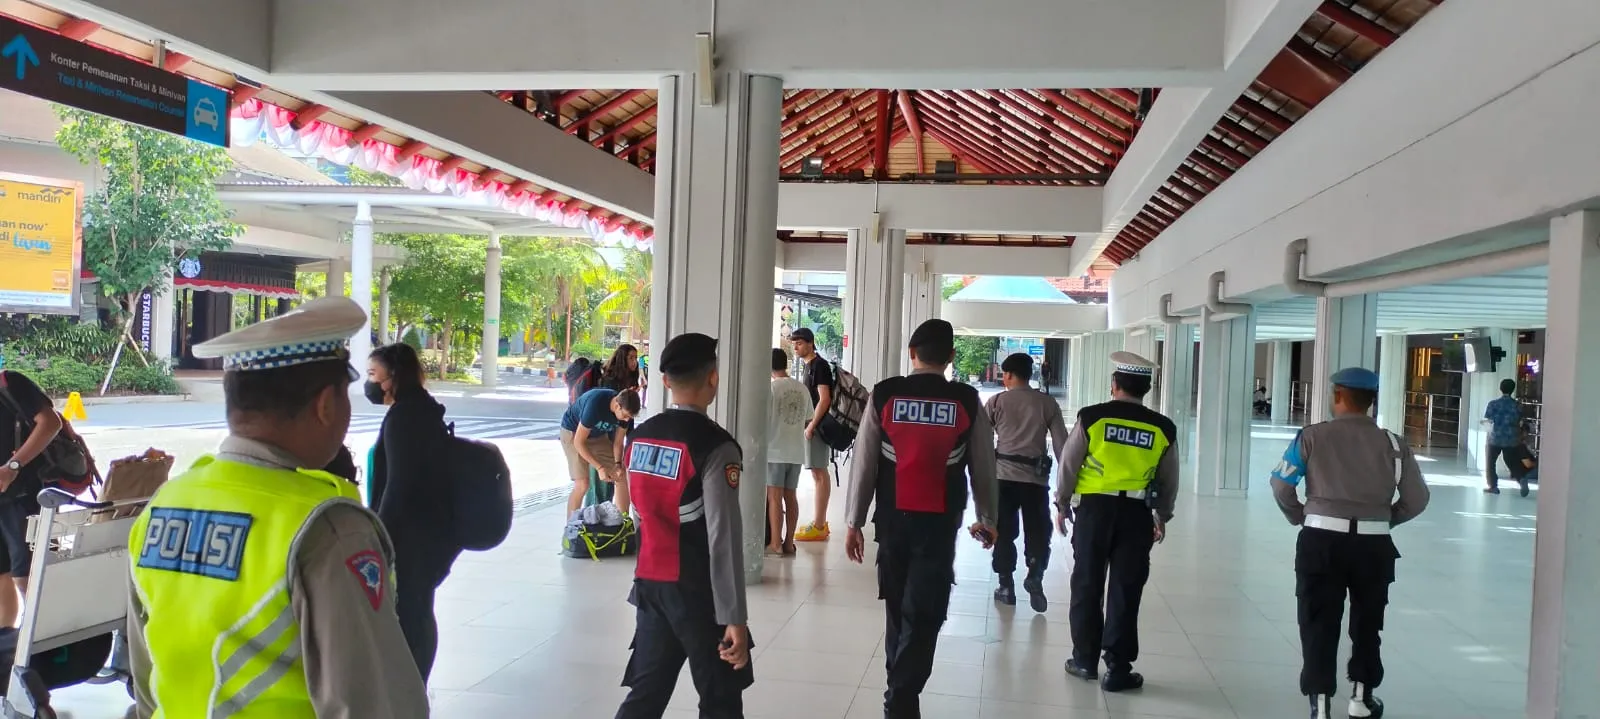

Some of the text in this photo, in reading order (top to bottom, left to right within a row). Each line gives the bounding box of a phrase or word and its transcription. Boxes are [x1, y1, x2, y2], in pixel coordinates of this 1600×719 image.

[50, 52, 186, 103] Konter Pemesanan Taksi & Minivan
[18, 191, 61, 204] mandiri
[0, 220, 16, 229] an
[894, 401, 954, 424] POLISI
[1106, 426, 1153, 447] POLISI
[630, 444, 679, 477] POLISI
[142, 518, 244, 568] POLISI
